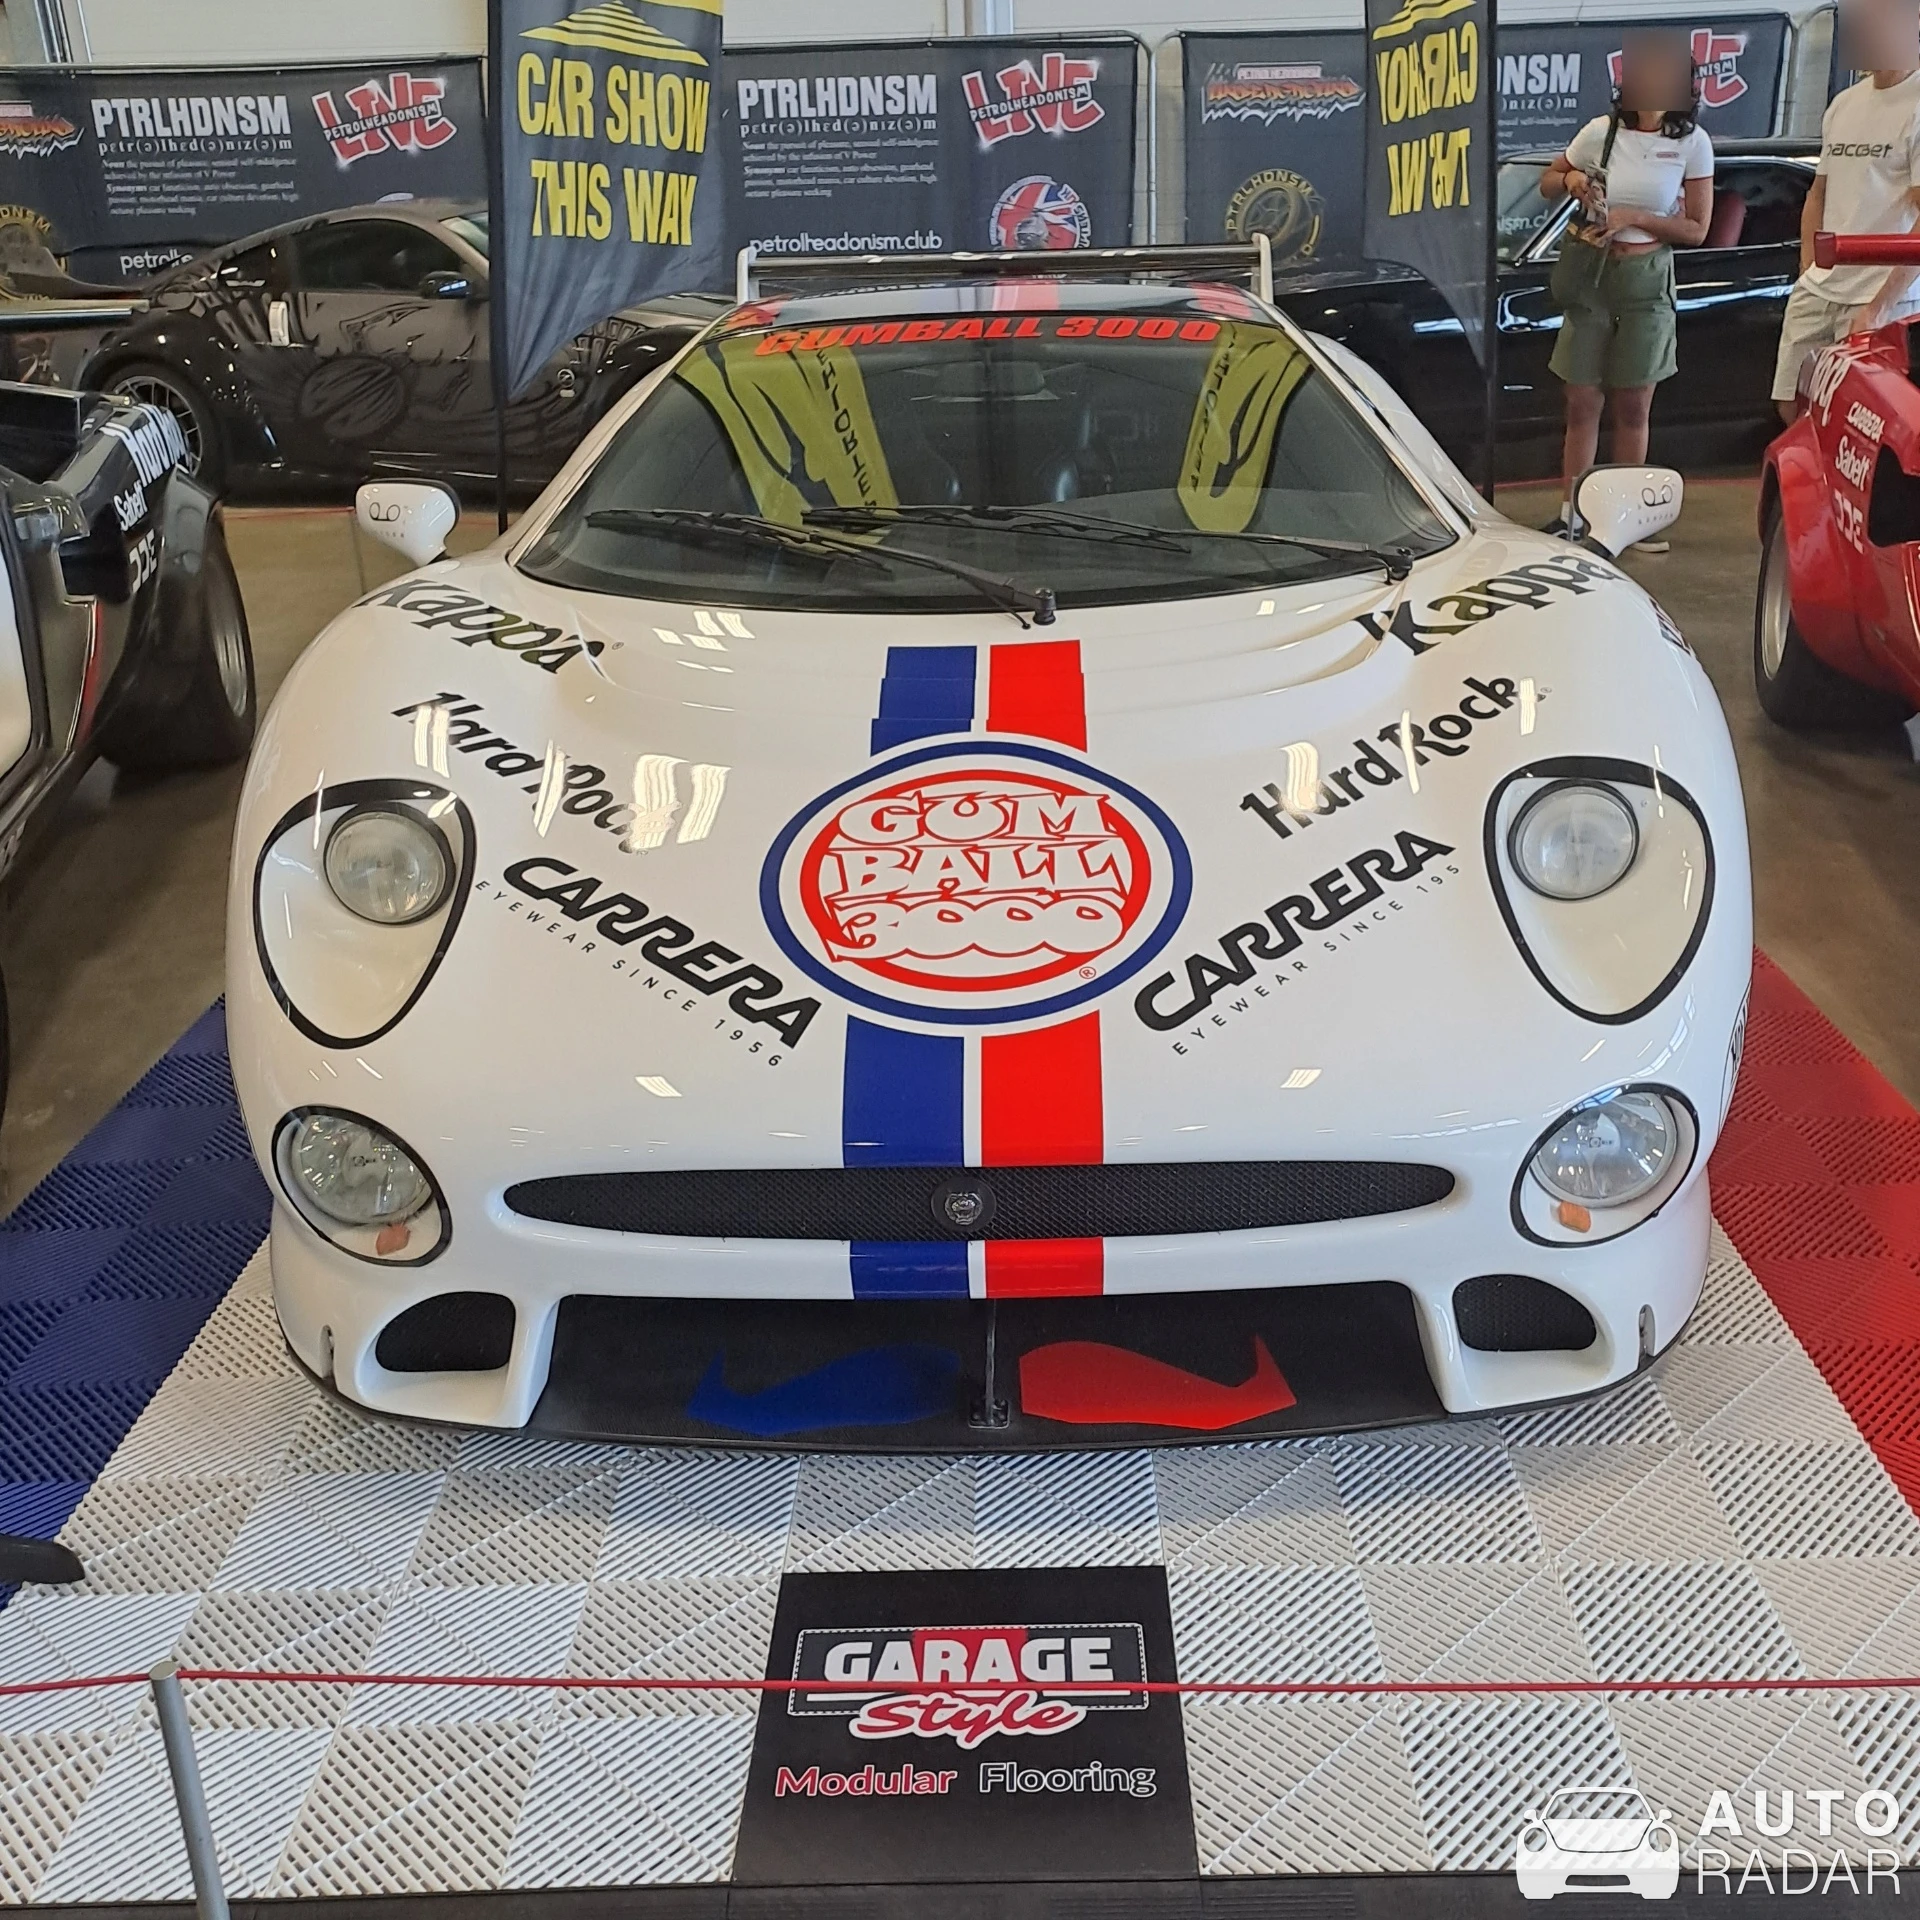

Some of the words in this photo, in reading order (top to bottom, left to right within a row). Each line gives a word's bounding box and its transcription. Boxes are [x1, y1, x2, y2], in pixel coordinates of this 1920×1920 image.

[90, 95, 293, 138] PTRLHDNSM
[311, 71, 457, 167] LIVE
[322, 101, 439, 142] PETROLHEADONISM
[517, 52, 595, 139] CAR
[605, 64, 711, 154] SHOW
[737, 73, 938, 120] PTRLHDNSM
[961, 52, 1105, 146] LIVE
[969, 84, 1090, 123] PETROLHEADONISM
[531, 159, 612, 241] THIS
[623, 167, 698, 246] WAY
[1225, 169, 1314, 232] PTRLHDNSM
[750, 229, 943, 264] petrolheadonism.club
[753, 316, 1044, 358] GUMBALL
[1055, 316, 1221, 342] 3000
[1834, 434, 1870, 492] Sabelt
[113, 479, 148, 532] Sabelt
[350, 578, 606, 675] Kappa
[1353, 553, 1632, 658] Kappa
[1238, 737, 1405, 841] Hard
[1376, 675, 1547, 768] Rock
[837, 789, 1122, 846] GUM
[823, 838, 1129, 901] BALL
[503, 856, 822, 1050] CARRERA
[821, 893, 1126, 963] 3000
[1134, 829, 1457, 1032] CARRERA
[474, 879, 598, 954] EYEWEAR
[611, 958, 698, 1012] SINCE
[712, 1017, 783, 1068] 1956
[1171, 960, 1309, 1056] EYEWEAR
[1323, 899, 1404, 952] SINCE
[822, 1635, 1115, 1684] GARAGE
[850, 1689, 1084, 1748] Style
[774, 1763, 958, 1798] Modular
[978, 1760, 1158, 1798] Flooring
